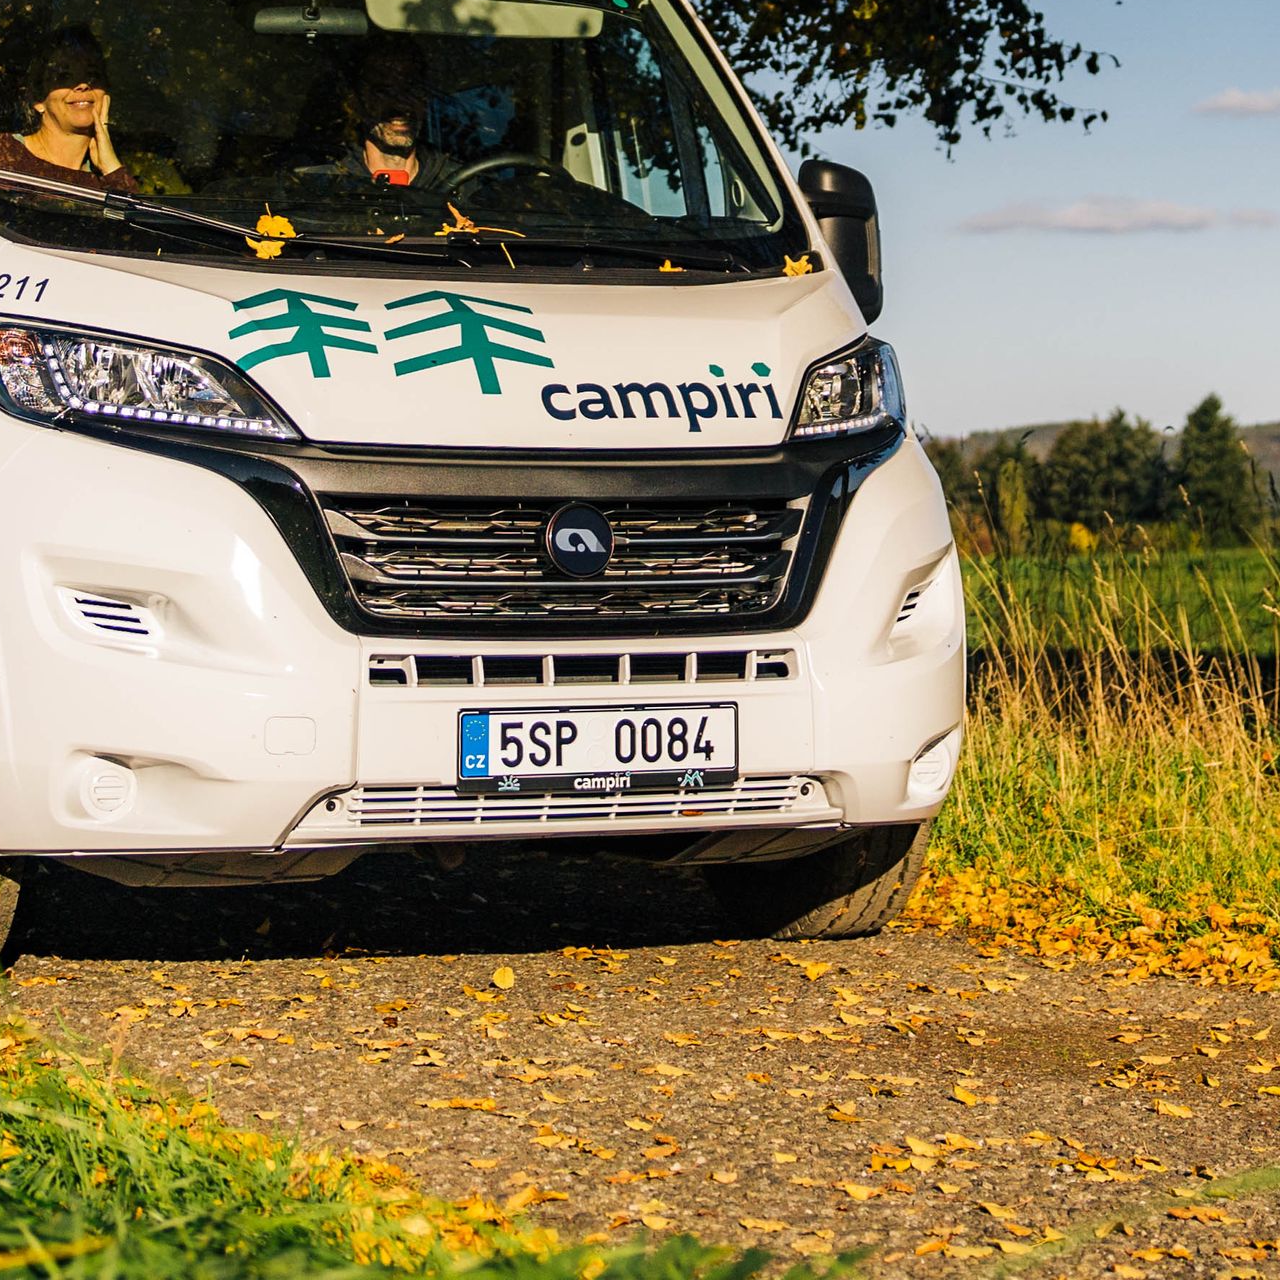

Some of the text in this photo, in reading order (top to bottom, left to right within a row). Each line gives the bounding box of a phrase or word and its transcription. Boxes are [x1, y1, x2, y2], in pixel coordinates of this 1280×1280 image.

[541, 362, 784, 432] campiri
[500, 716, 715, 768] 5SP 0084
[465, 754, 486, 769] CZ
[574, 771, 632, 792] campiri
